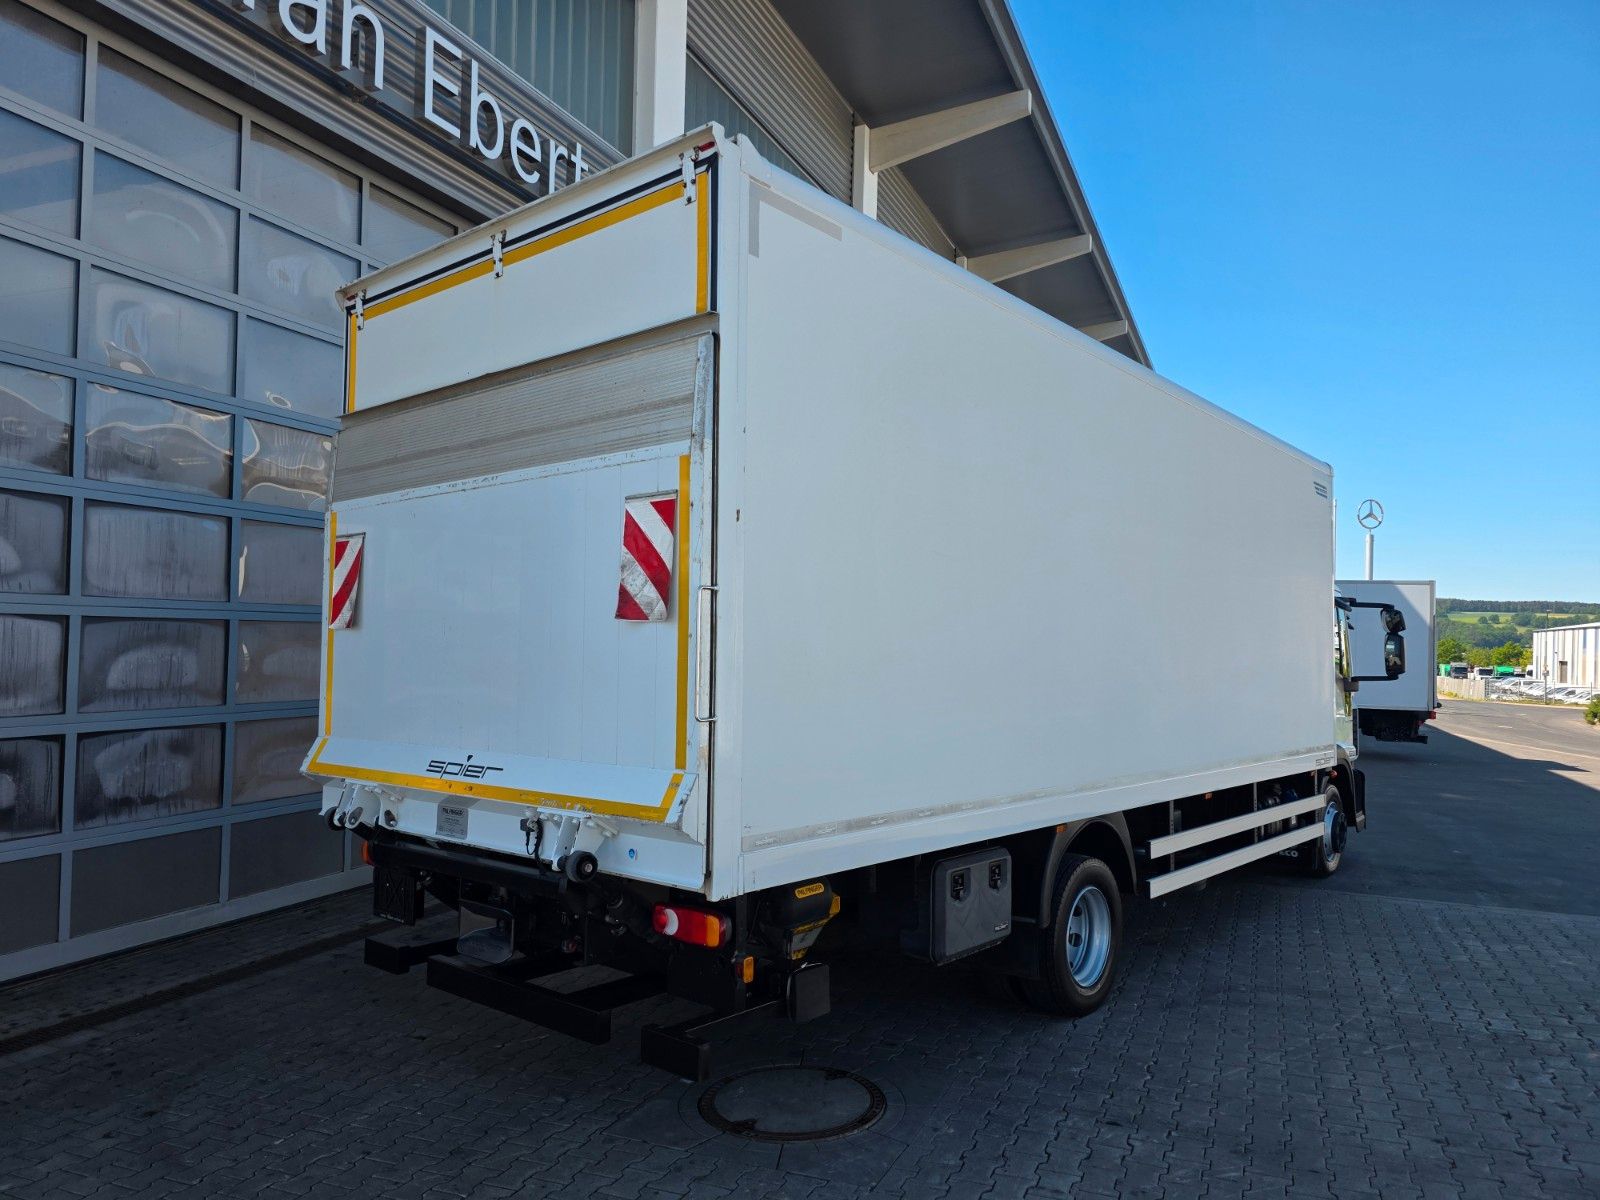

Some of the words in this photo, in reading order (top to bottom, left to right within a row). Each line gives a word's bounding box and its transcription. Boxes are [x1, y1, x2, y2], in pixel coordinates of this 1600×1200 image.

[243, 0, 385, 90] an
[425, 26, 589, 195] Ebert
[426, 754, 504, 780] spier
